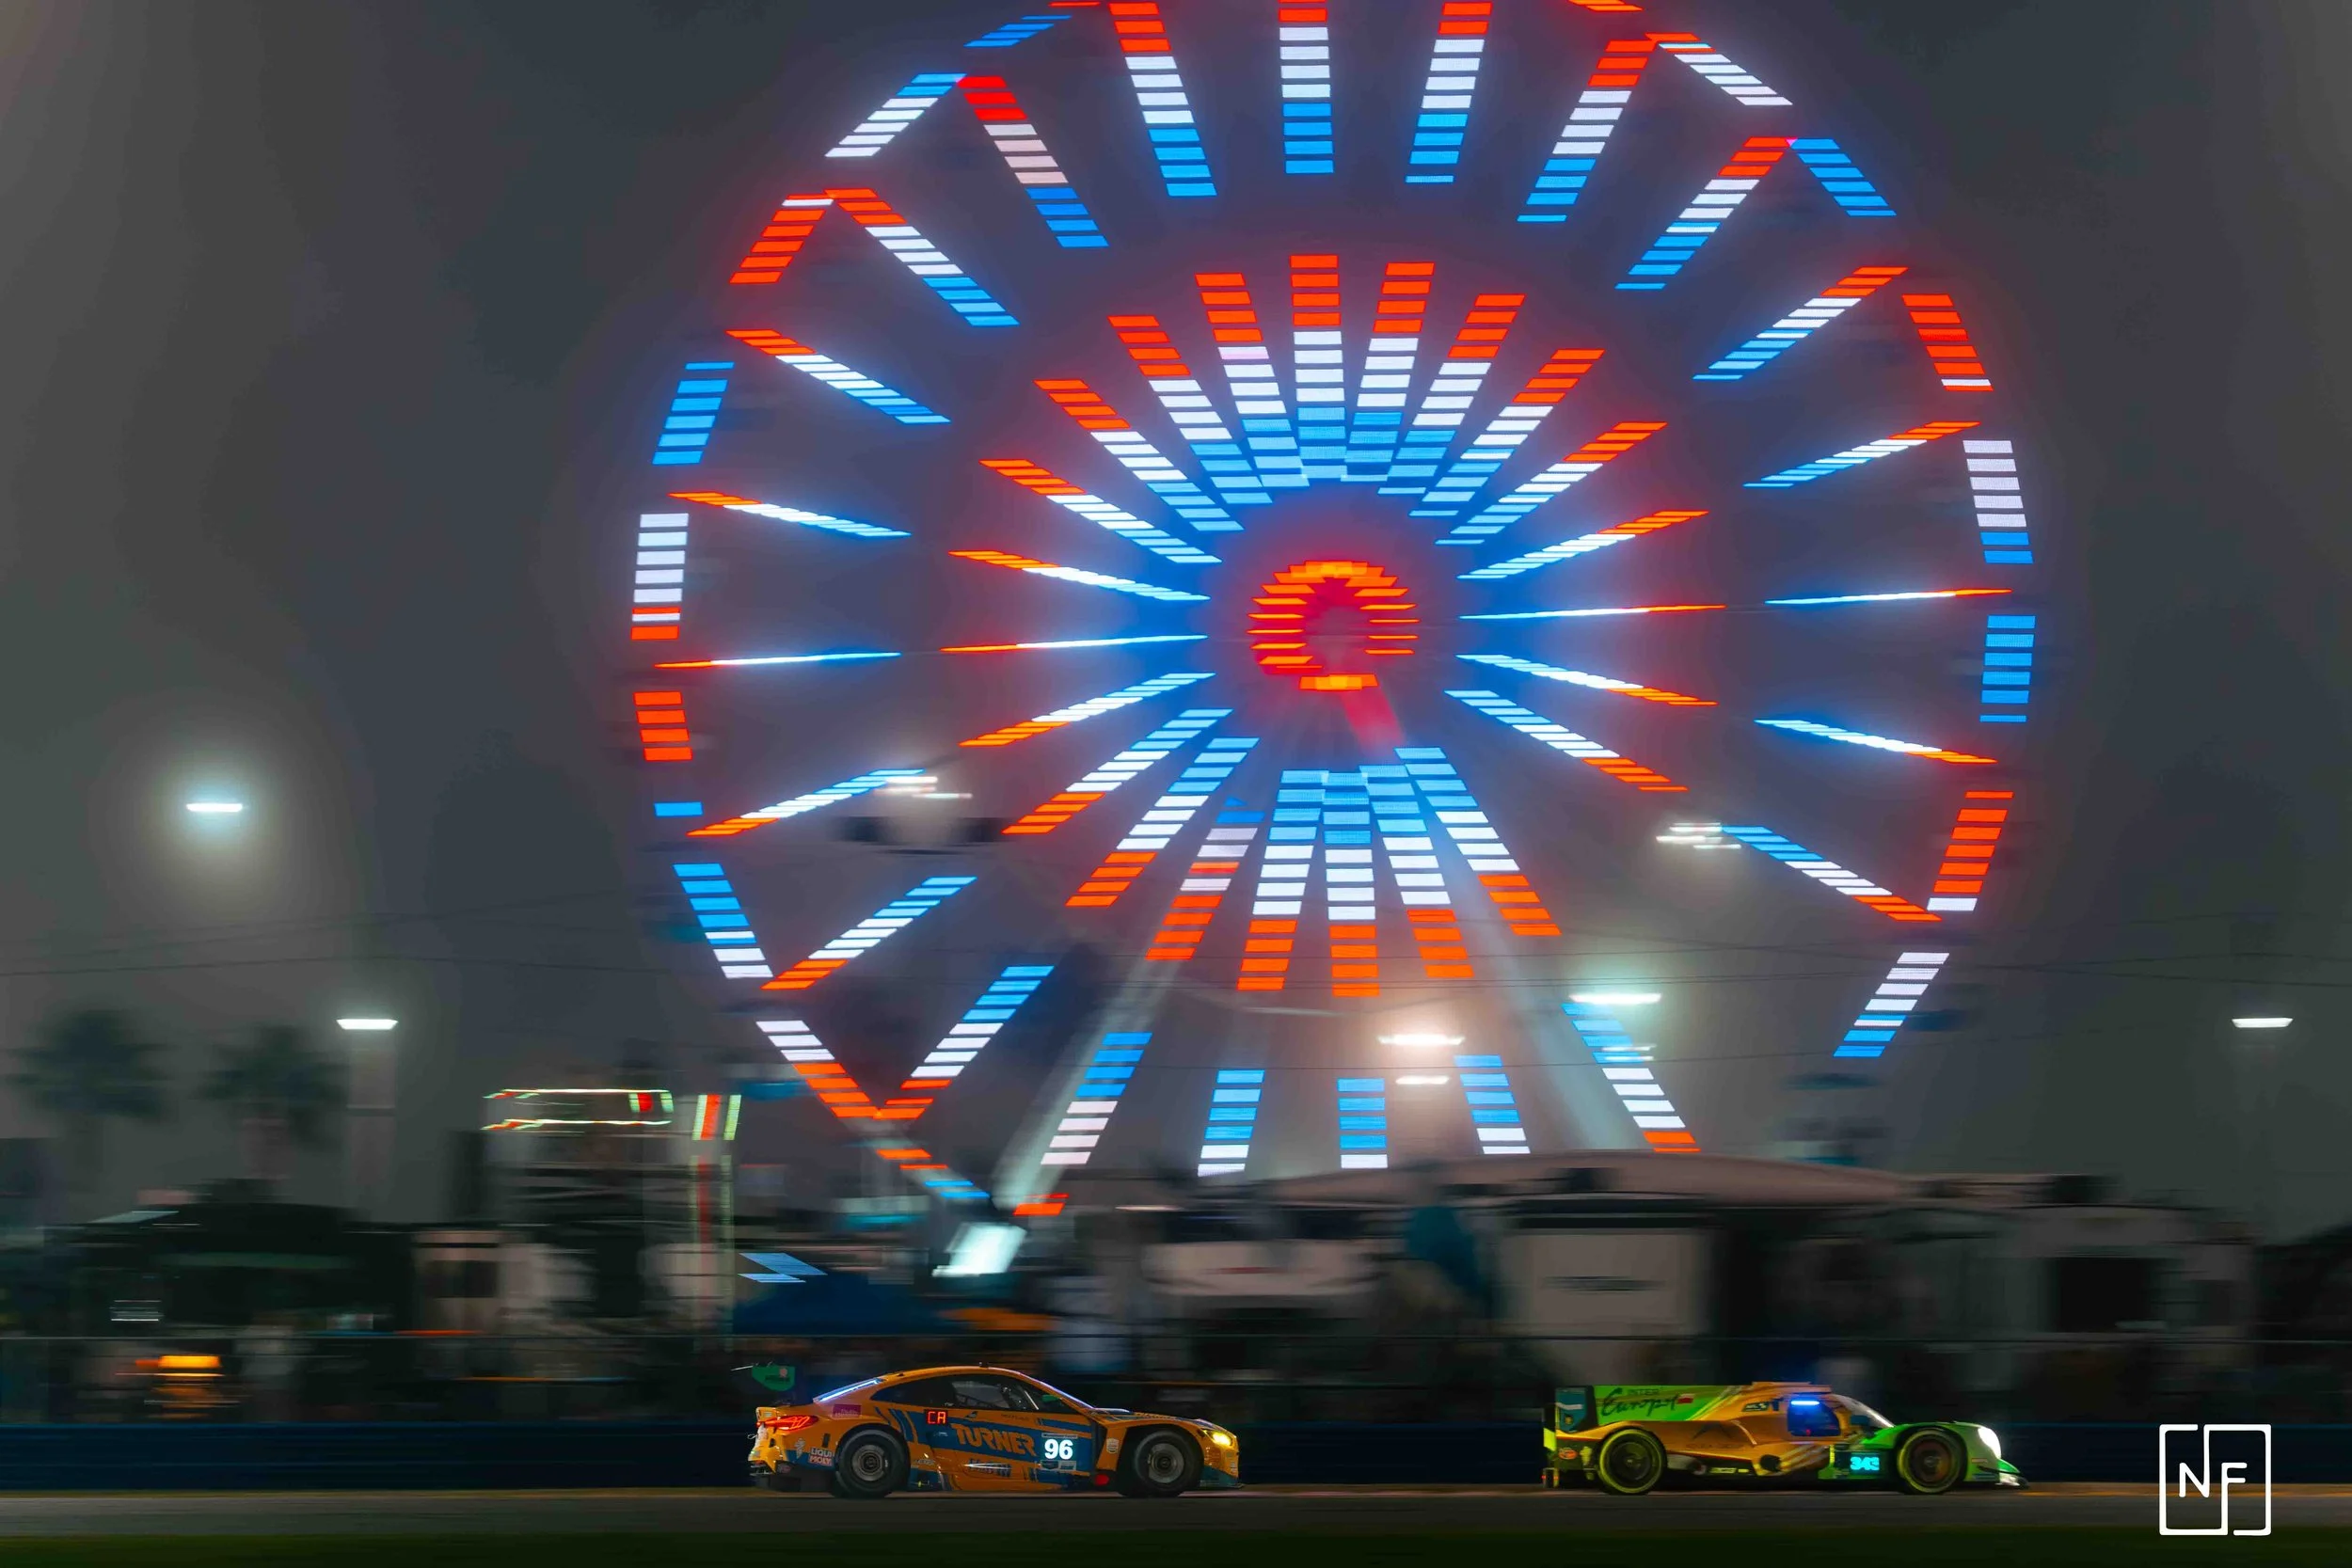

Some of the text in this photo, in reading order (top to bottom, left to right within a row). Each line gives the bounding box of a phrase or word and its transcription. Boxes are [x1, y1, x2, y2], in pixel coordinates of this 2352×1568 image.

[949, 1423, 1037, 1457] TURNER
[1044, 1438, 1074, 1460] 96
[809, 1455, 833, 1466] MOLY
